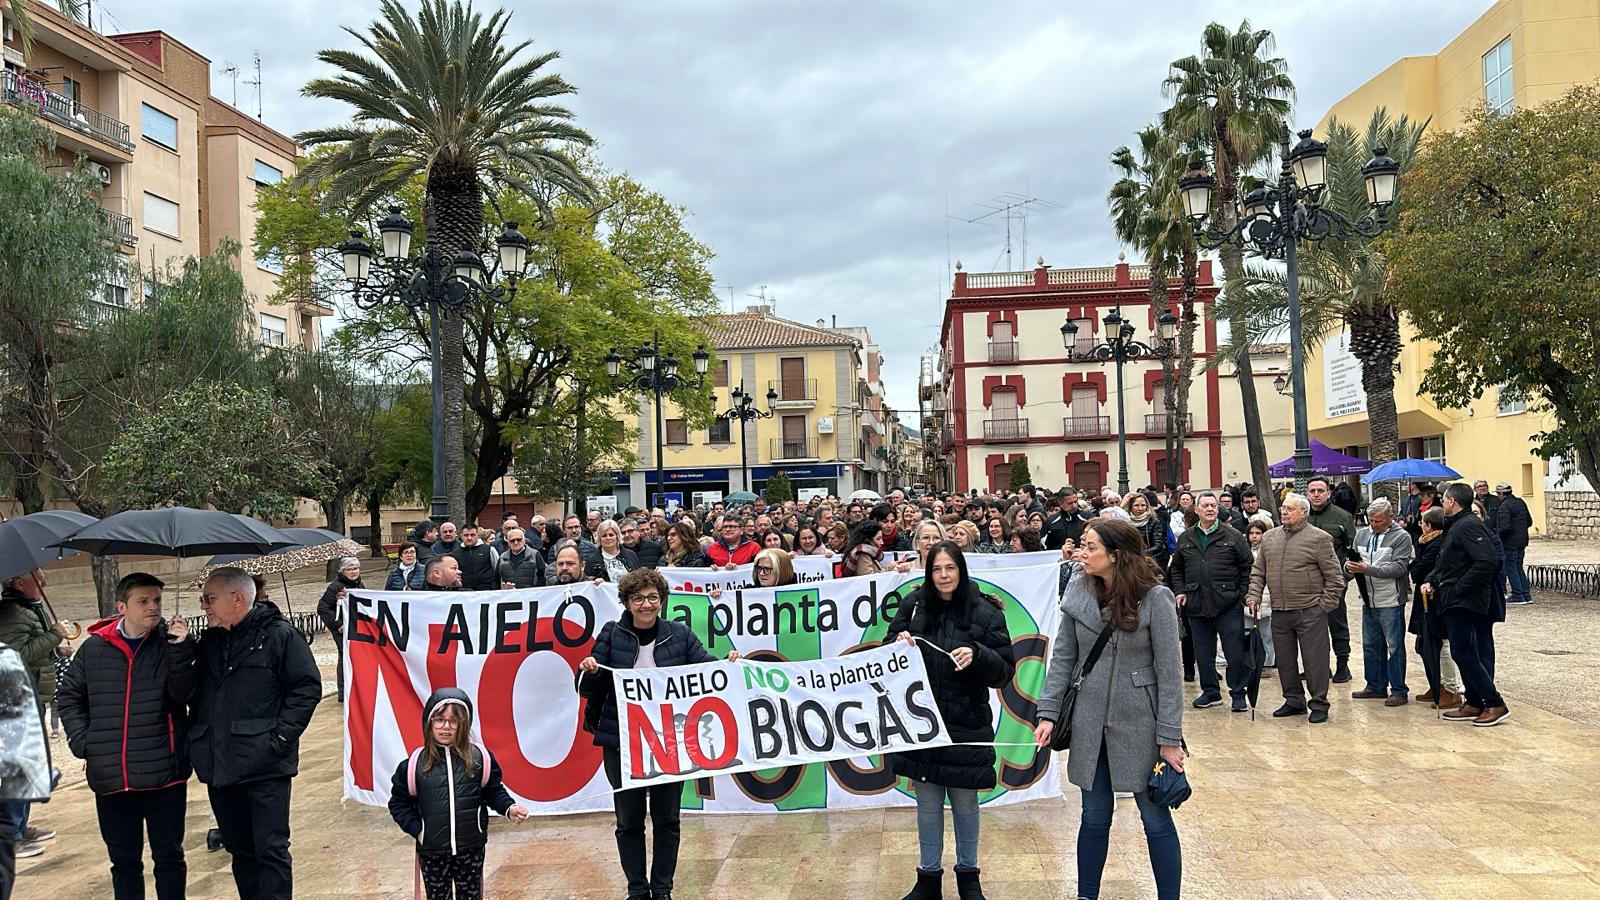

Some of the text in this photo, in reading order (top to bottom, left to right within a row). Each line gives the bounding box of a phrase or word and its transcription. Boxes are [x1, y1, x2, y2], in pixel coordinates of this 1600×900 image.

[347, 593, 410, 653] EN
[438, 595, 596, 655] AIELO
[707, 590, 839, 649] planta
[852, 580, 904, 629] de
[347, 616, 606, 803] NO
[623, 652, 909, 701] EN AIELO NO a la planta de
[627, 696, 739, 777] NO
[747, 680, 940, 760] BIOGÀS
